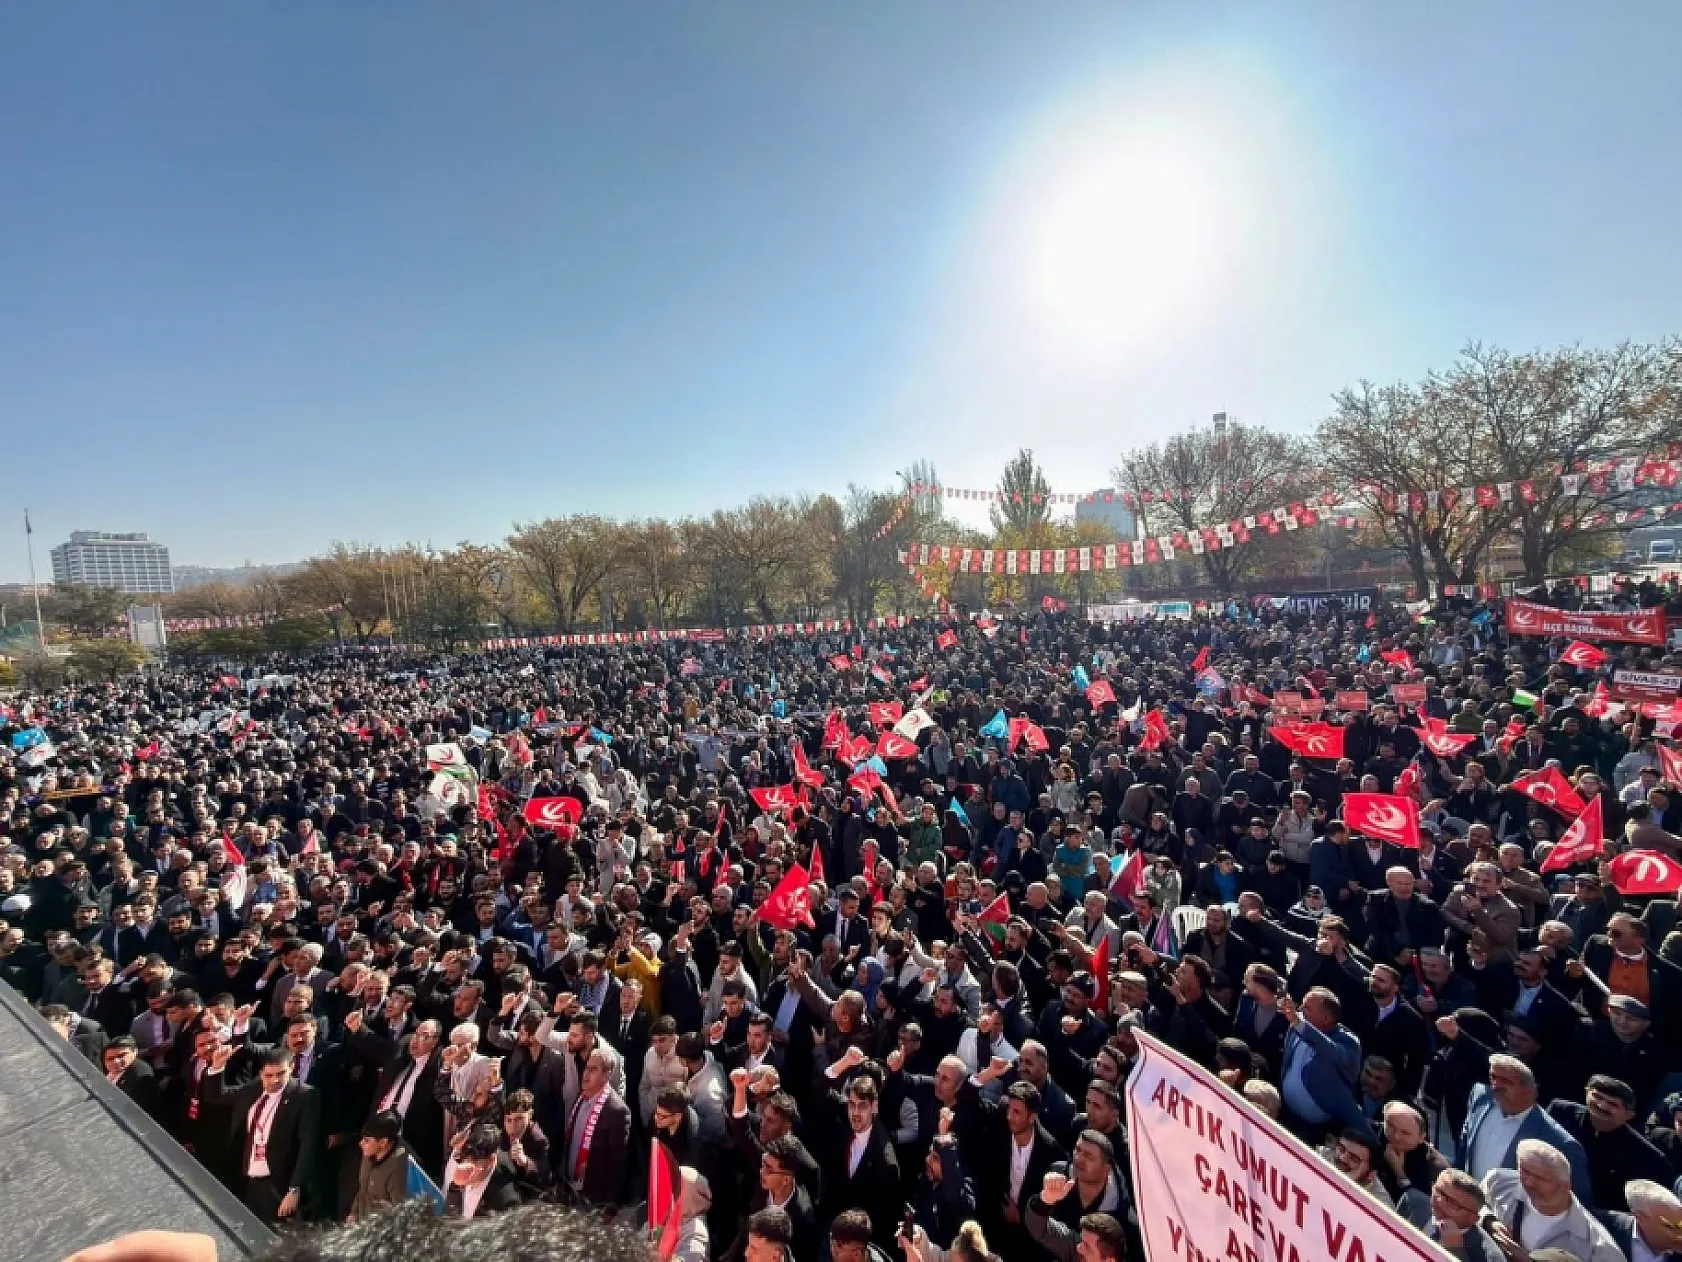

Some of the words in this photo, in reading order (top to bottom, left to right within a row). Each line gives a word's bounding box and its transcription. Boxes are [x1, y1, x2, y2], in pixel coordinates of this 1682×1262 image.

[1152, 1077, 1226, 1152] ARTIK
[1230, 1130, 1309, 1229] UMUT
[1321, 1206, 1386, 1262] VA
[1193, 1153, 1265, 1240] ÇARE
